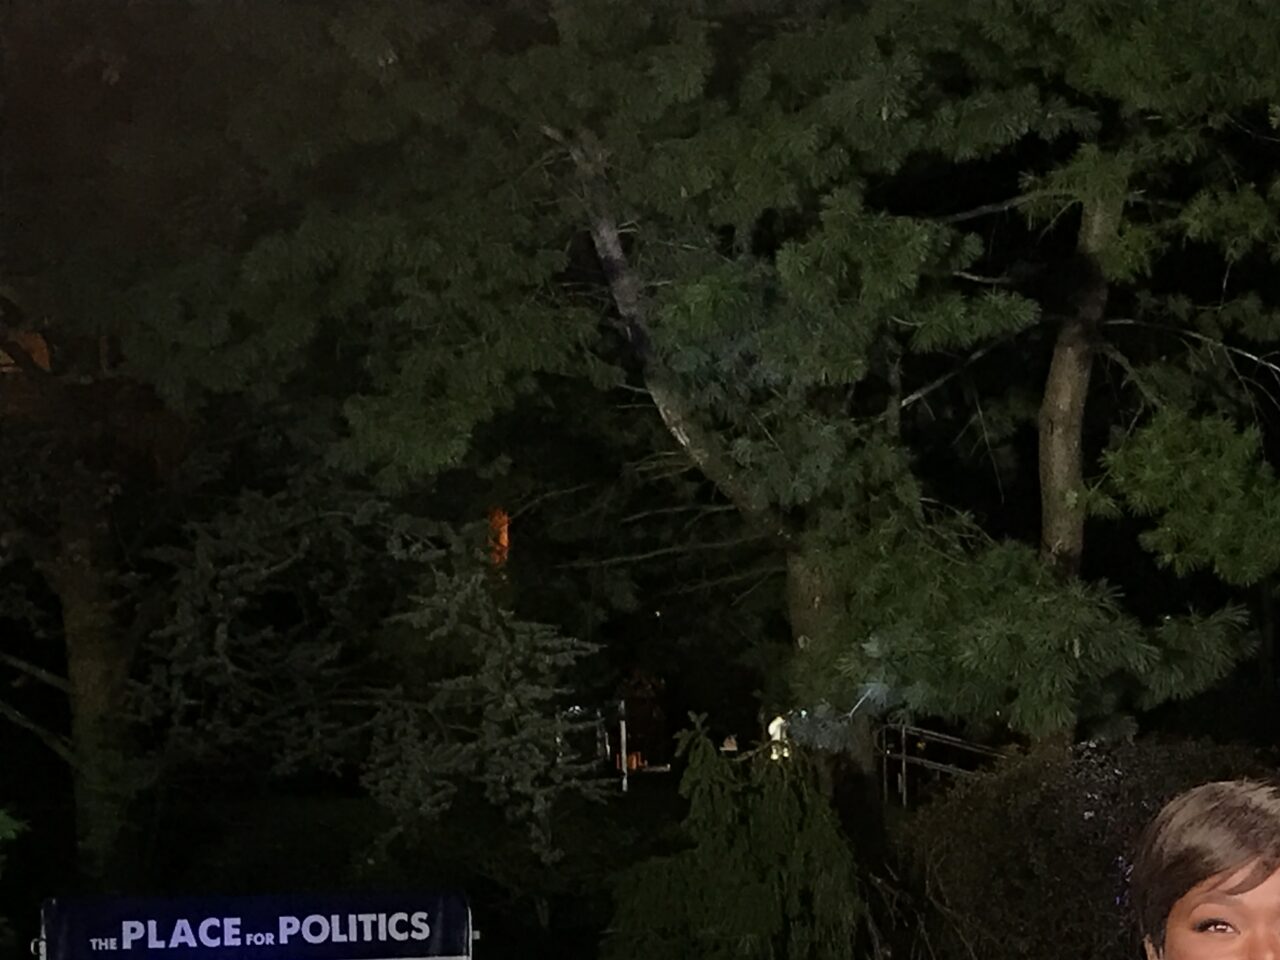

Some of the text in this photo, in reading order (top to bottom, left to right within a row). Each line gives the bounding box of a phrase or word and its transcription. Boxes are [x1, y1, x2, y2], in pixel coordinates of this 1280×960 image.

[90, 911, 430, 950] THE PLACE FOR POLITICS
